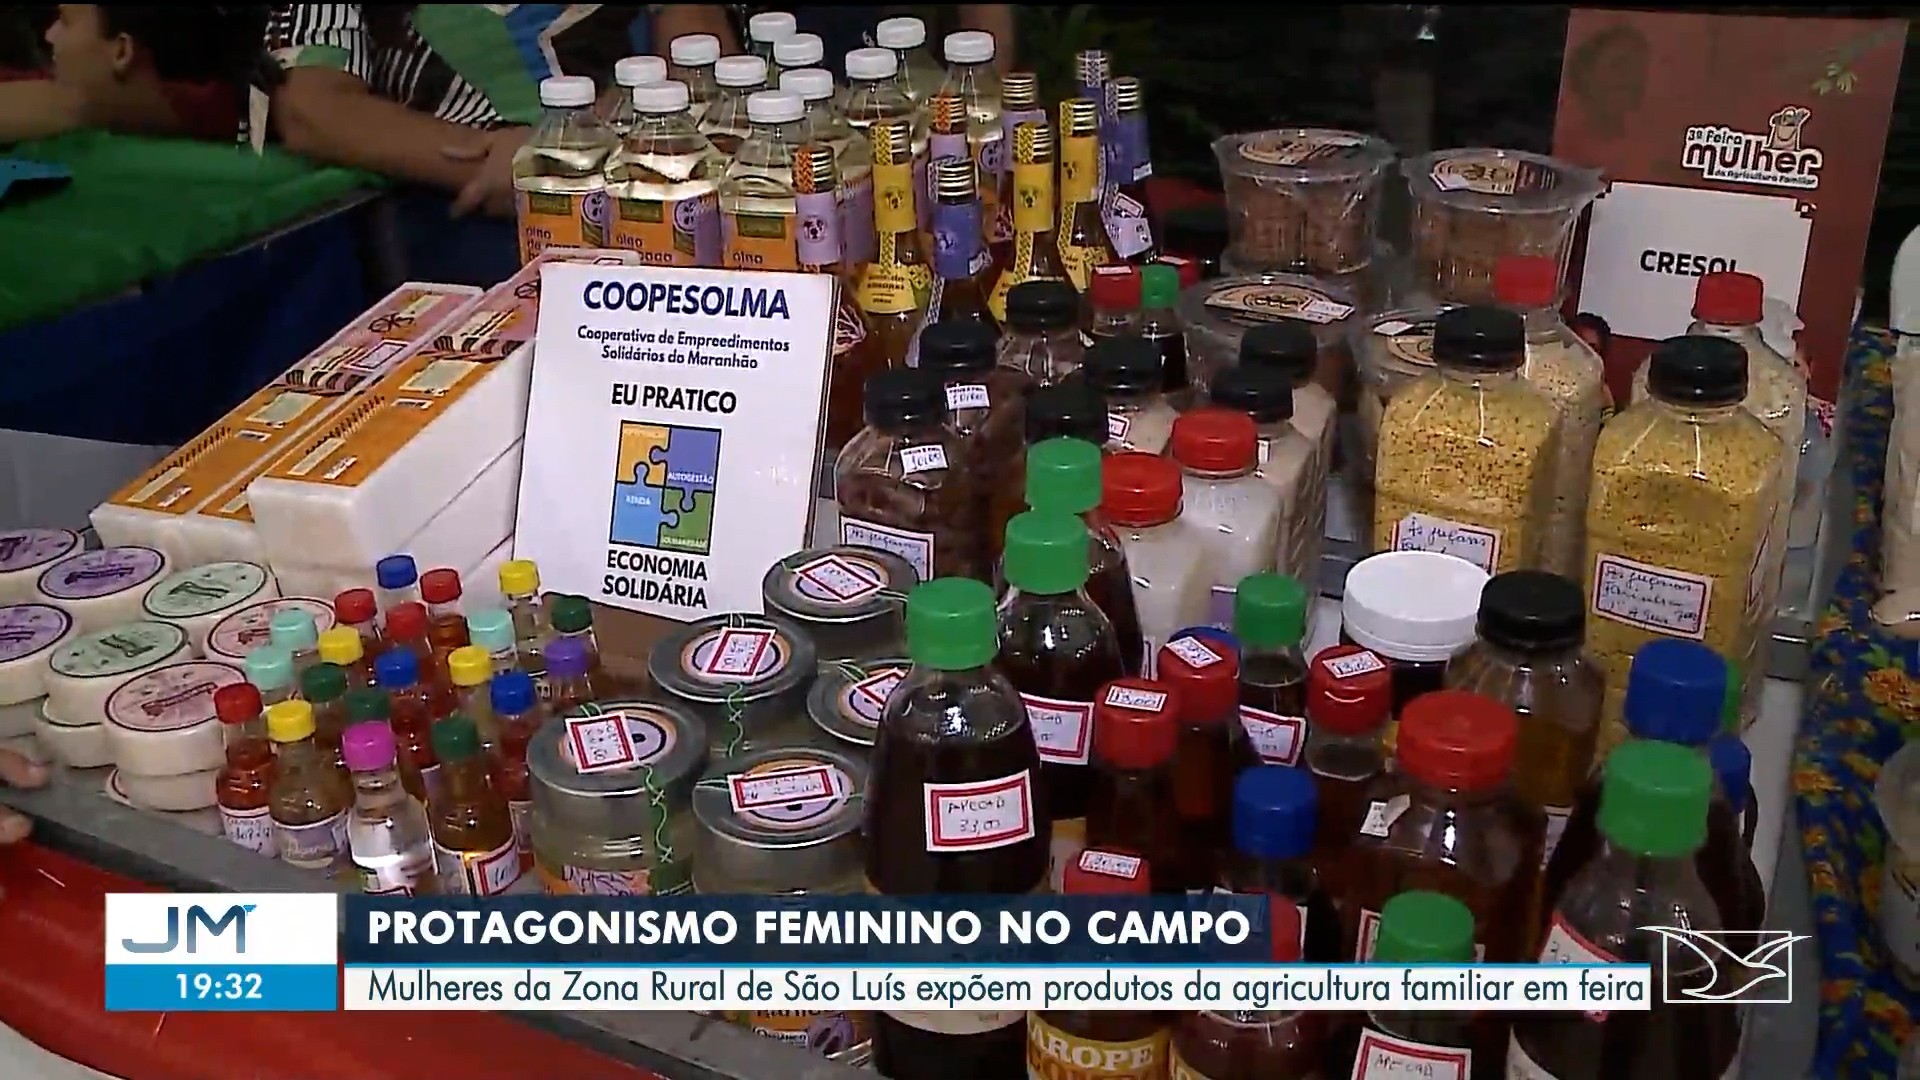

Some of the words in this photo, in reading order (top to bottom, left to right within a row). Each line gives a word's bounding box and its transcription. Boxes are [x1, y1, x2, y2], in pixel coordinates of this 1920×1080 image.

[1706, 130, 1742, 145] Feira
[1686, 139, 1819, 176] mulher
[583, 281, 790, 320] COOPESOLMA
[577, 324, 655, 344] Cooperativa
[658, 329, 674, 344] de
[677, 331, 790, 352] Empreedimentos
[601, 345, 665, 364] Solidários
[668, 350, 685, 364] do
[687, 351, 758, 369] Maranhão
[612, 383, 638, 406] EU
[642, 385, 737, 414] PRATICO
[607, 550, 708, 581] ECONOMIA
[601, 572, 708, 609] SOLIDÁRIA
[1030, 1023, 1154, 1071] AROPE
